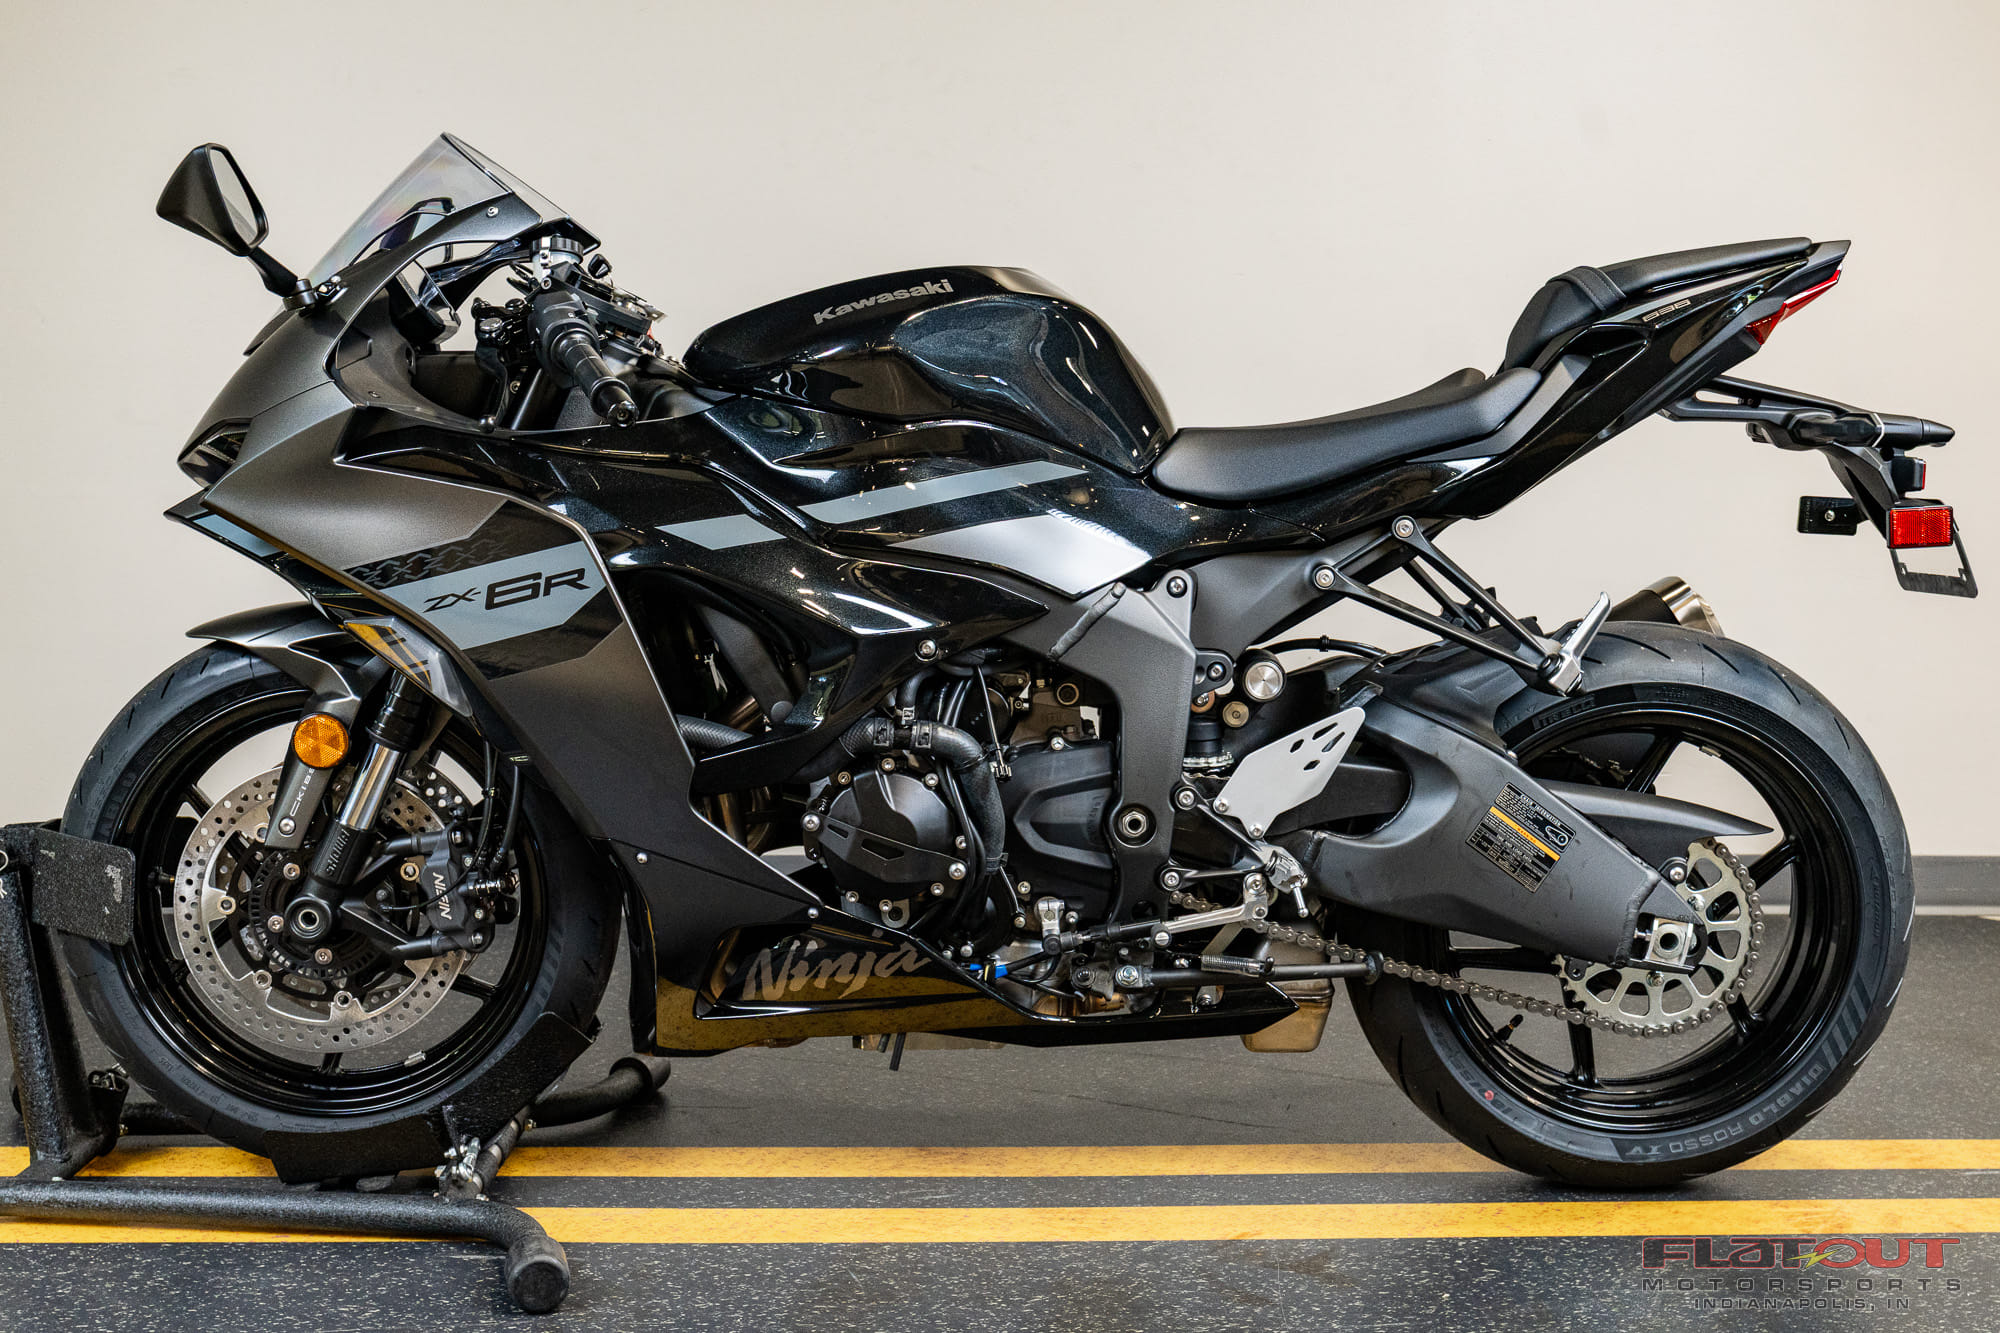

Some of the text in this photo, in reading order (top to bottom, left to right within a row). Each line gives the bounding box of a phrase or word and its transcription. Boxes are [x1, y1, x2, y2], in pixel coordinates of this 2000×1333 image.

[813, 278, 954, 325] Kawasaki
[422, 567, 591, 613] ZX-6R
[742, 940, 932, 1000] Ninja
